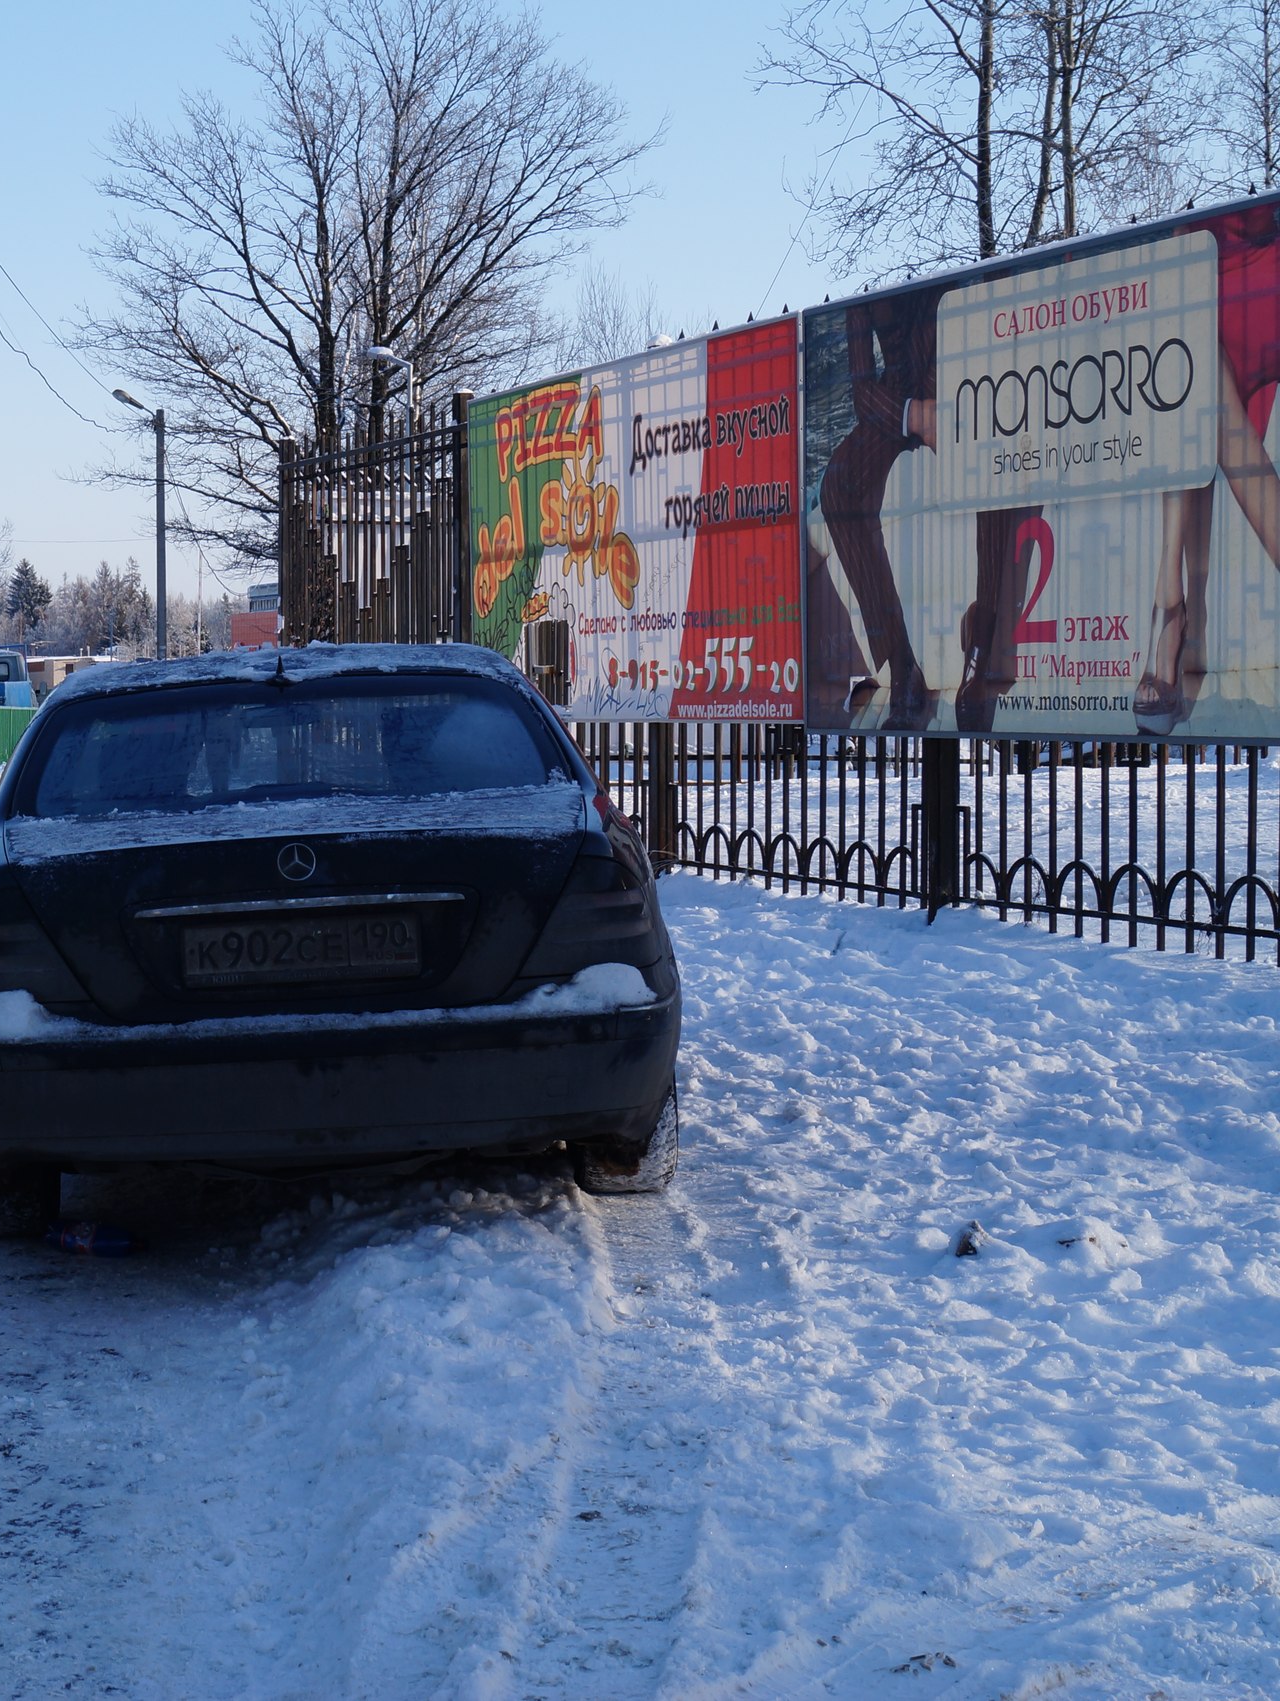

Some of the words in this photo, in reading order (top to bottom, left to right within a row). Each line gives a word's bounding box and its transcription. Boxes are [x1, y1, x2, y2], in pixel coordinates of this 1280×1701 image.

[993, 299, 1067, 339] САЛОН
[1071, 281, 1149, 324] ОБУВИ
[495, 382, 604, 483] PIZZA
[629, 412, 712, 477] Доставка
[715, 394, 790, 457] вкусной
[993, 447, 1041, 475] shoes
[1045, 443, 1058, 468] in
[1062, 440, 1099, 473] your
[1102, 429, 1143, 466] style
[664, 482, 732, 540] горячей
[734, 480, 791, 528] пиццы
[473, 475, 525, 619] del
[1012, 515, 1058, 643] 2
[1063, 615, 1130, 642] этаж
[578, 612, 617, 637] Сделано
[621, 617, 626, 632] с
[630, 607, 677, 631] любовью
[608, 636, 800, 694] 8-915-02-555-20
[1014, 654, 1037, 683] ТЦ
[677, 699, 793, 719] www.pizzadelsole.ru
[998, 694, 1129, 712] www.monsorro.ru
[352, 919, 409, 949] 190
